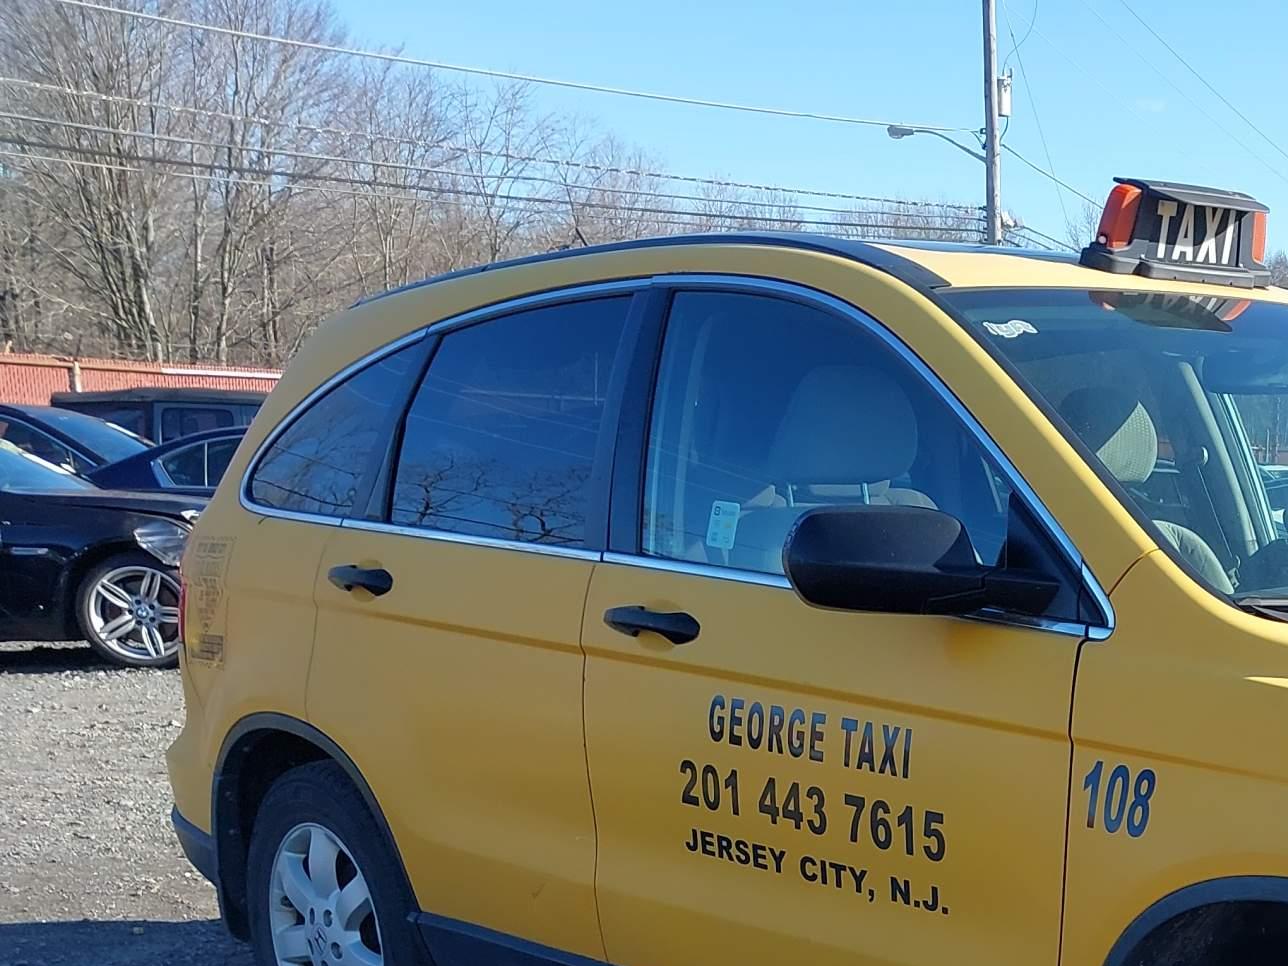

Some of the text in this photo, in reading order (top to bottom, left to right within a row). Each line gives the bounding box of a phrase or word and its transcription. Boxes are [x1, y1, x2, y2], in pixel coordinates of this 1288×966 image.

[1156, 200, 1236, 265] TAXI
[708, 692, 913, 780] GEORGE TAXI
[679, 759, 946, 863] 201 443 7615
[1082, 759, 1158, 839] 108
[685, 828, 950, 915] JERSEY CITY, N.J.
